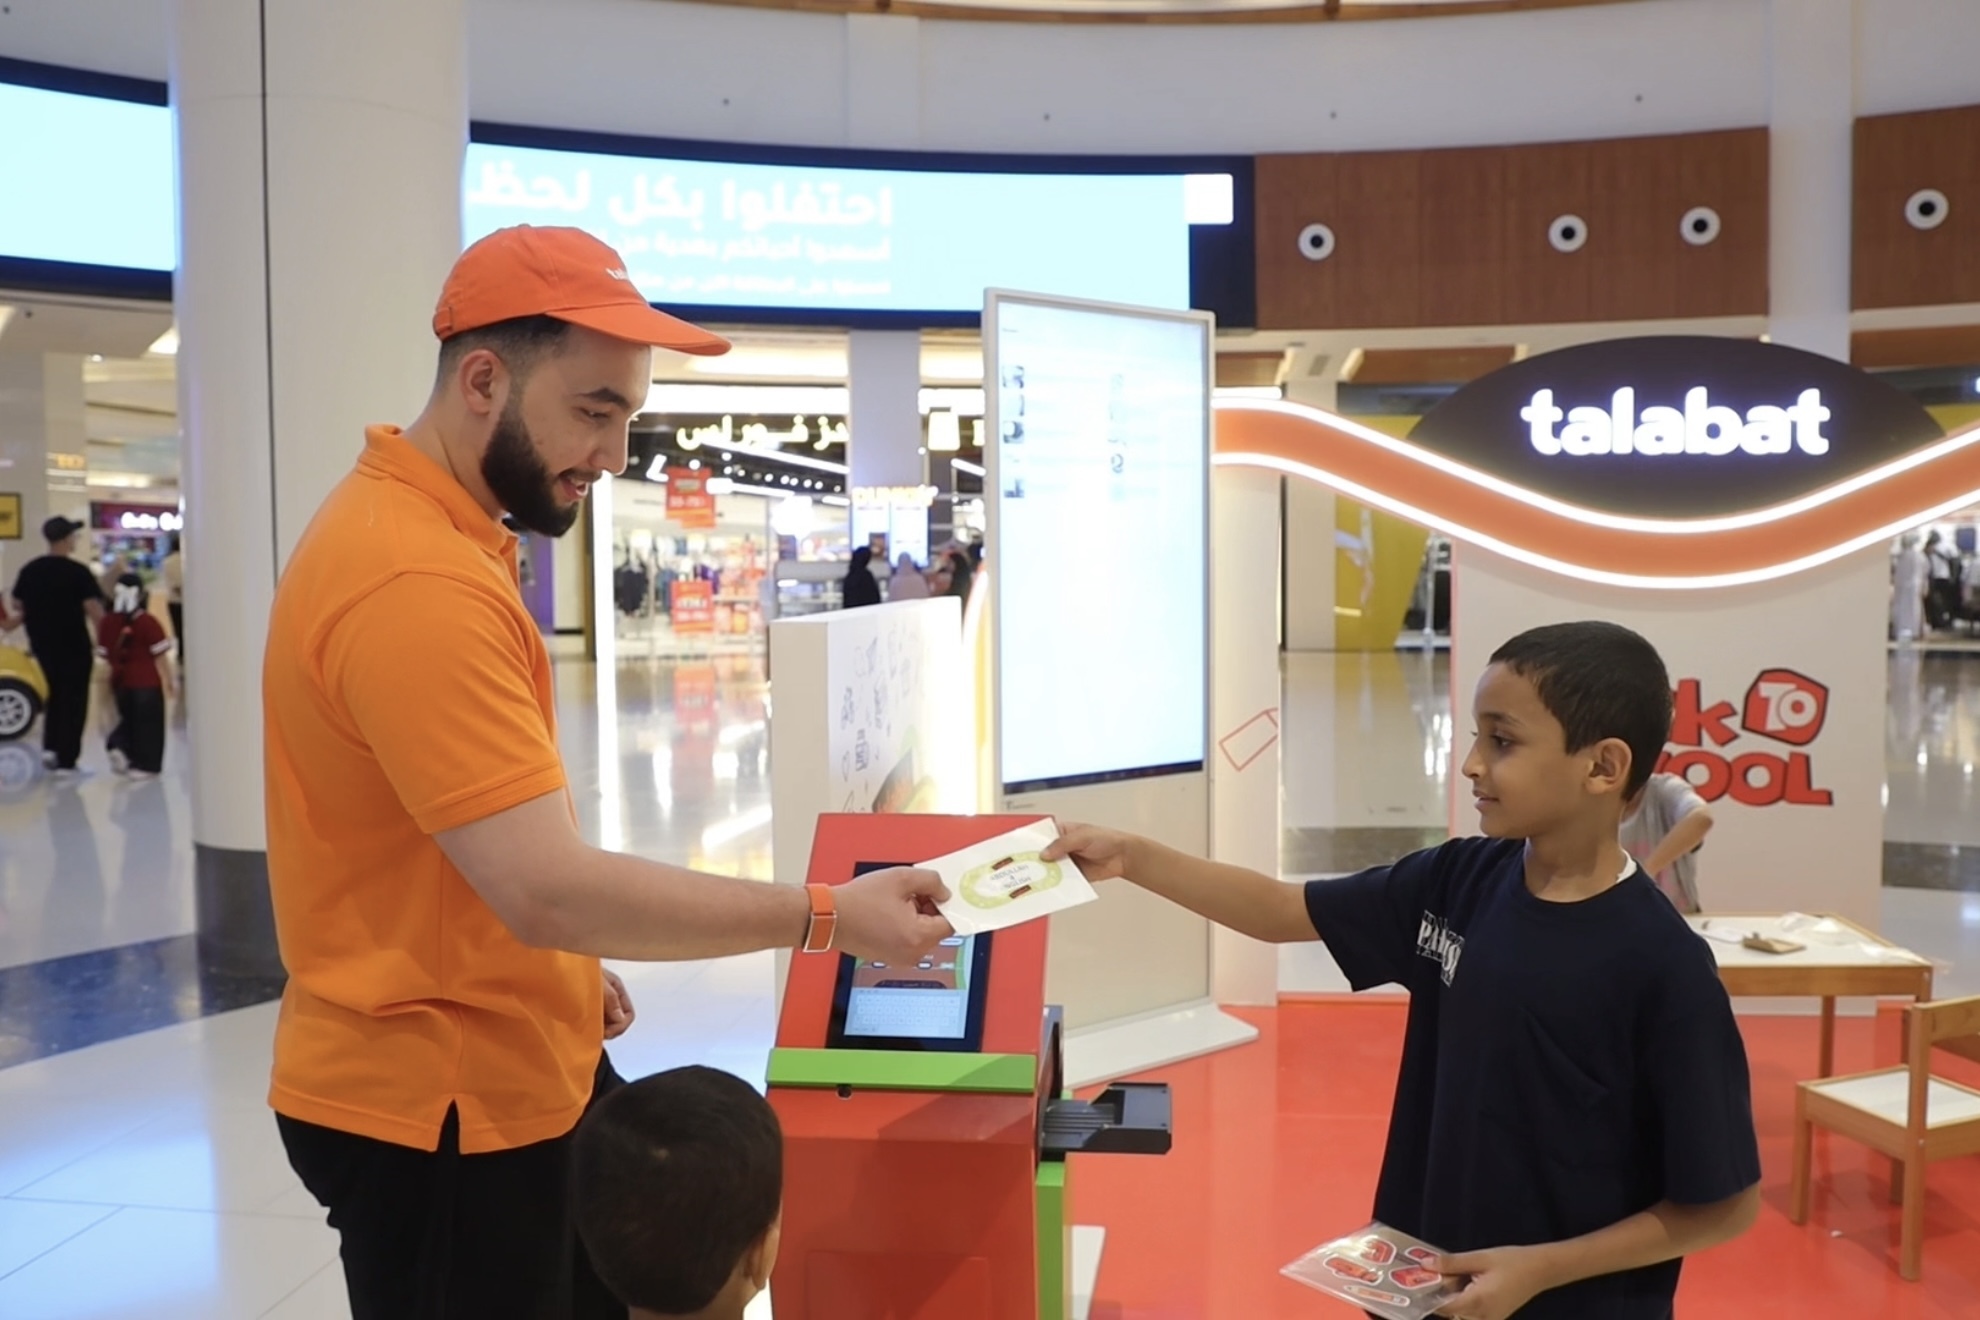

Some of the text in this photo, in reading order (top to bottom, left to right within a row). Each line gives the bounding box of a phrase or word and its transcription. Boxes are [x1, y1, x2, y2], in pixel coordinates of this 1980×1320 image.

[607, 173, 705, 230] بكل
[722, 178, 892, 231] احتفلوا
[1521, 386, 1830, 456] talabat
[1667, 678, 1819, 747] k TO
